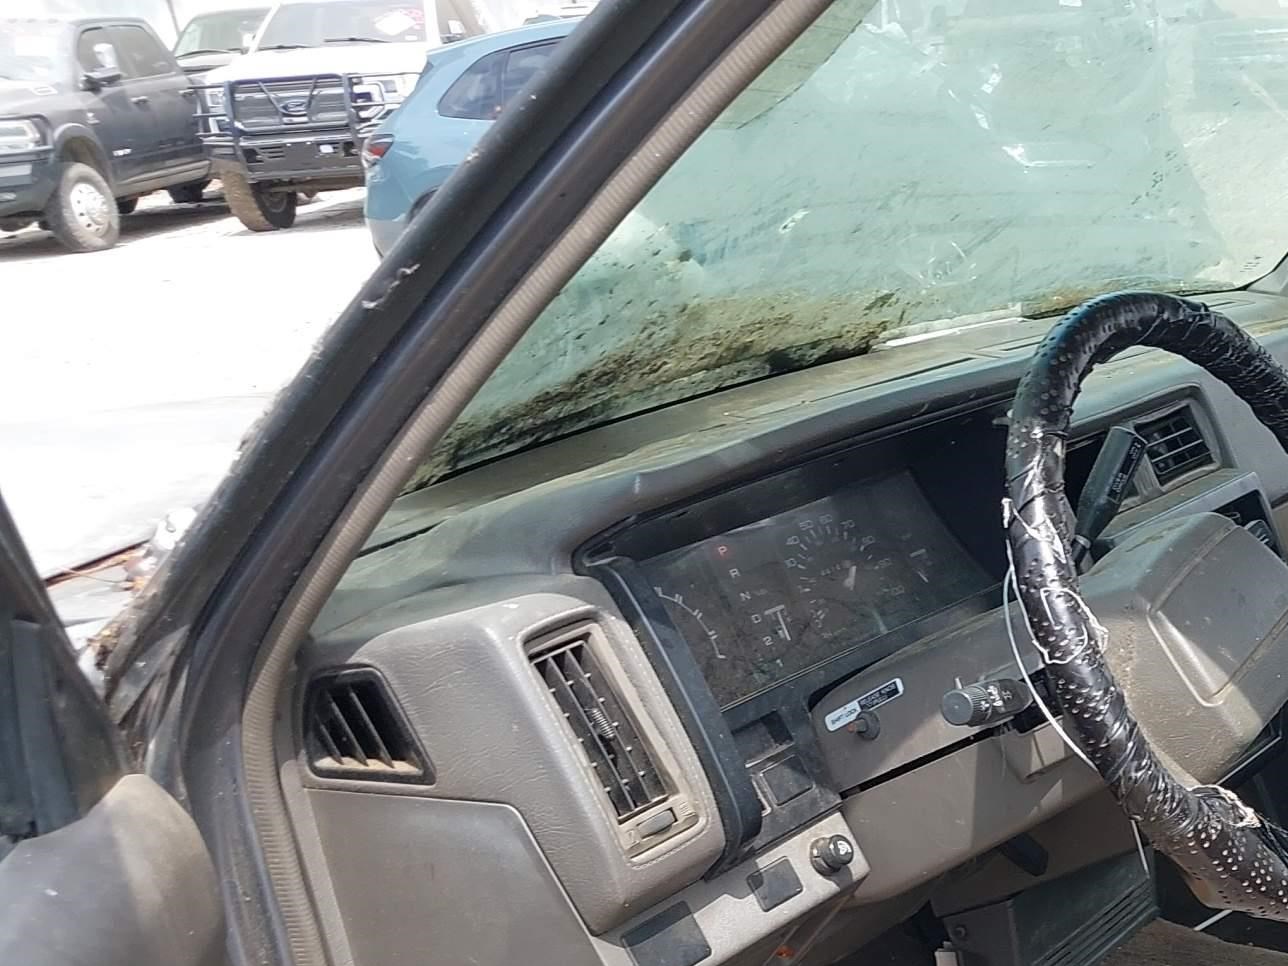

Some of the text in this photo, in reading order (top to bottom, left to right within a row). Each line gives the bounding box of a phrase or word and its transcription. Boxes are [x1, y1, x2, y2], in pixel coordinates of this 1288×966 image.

[717, 545, 729, 557] P
[729, 568, 741, 580] R
[740, 591, 752, 601] N
[751, 613, 762, 624] D
[762, 635, 774, 647] 2
